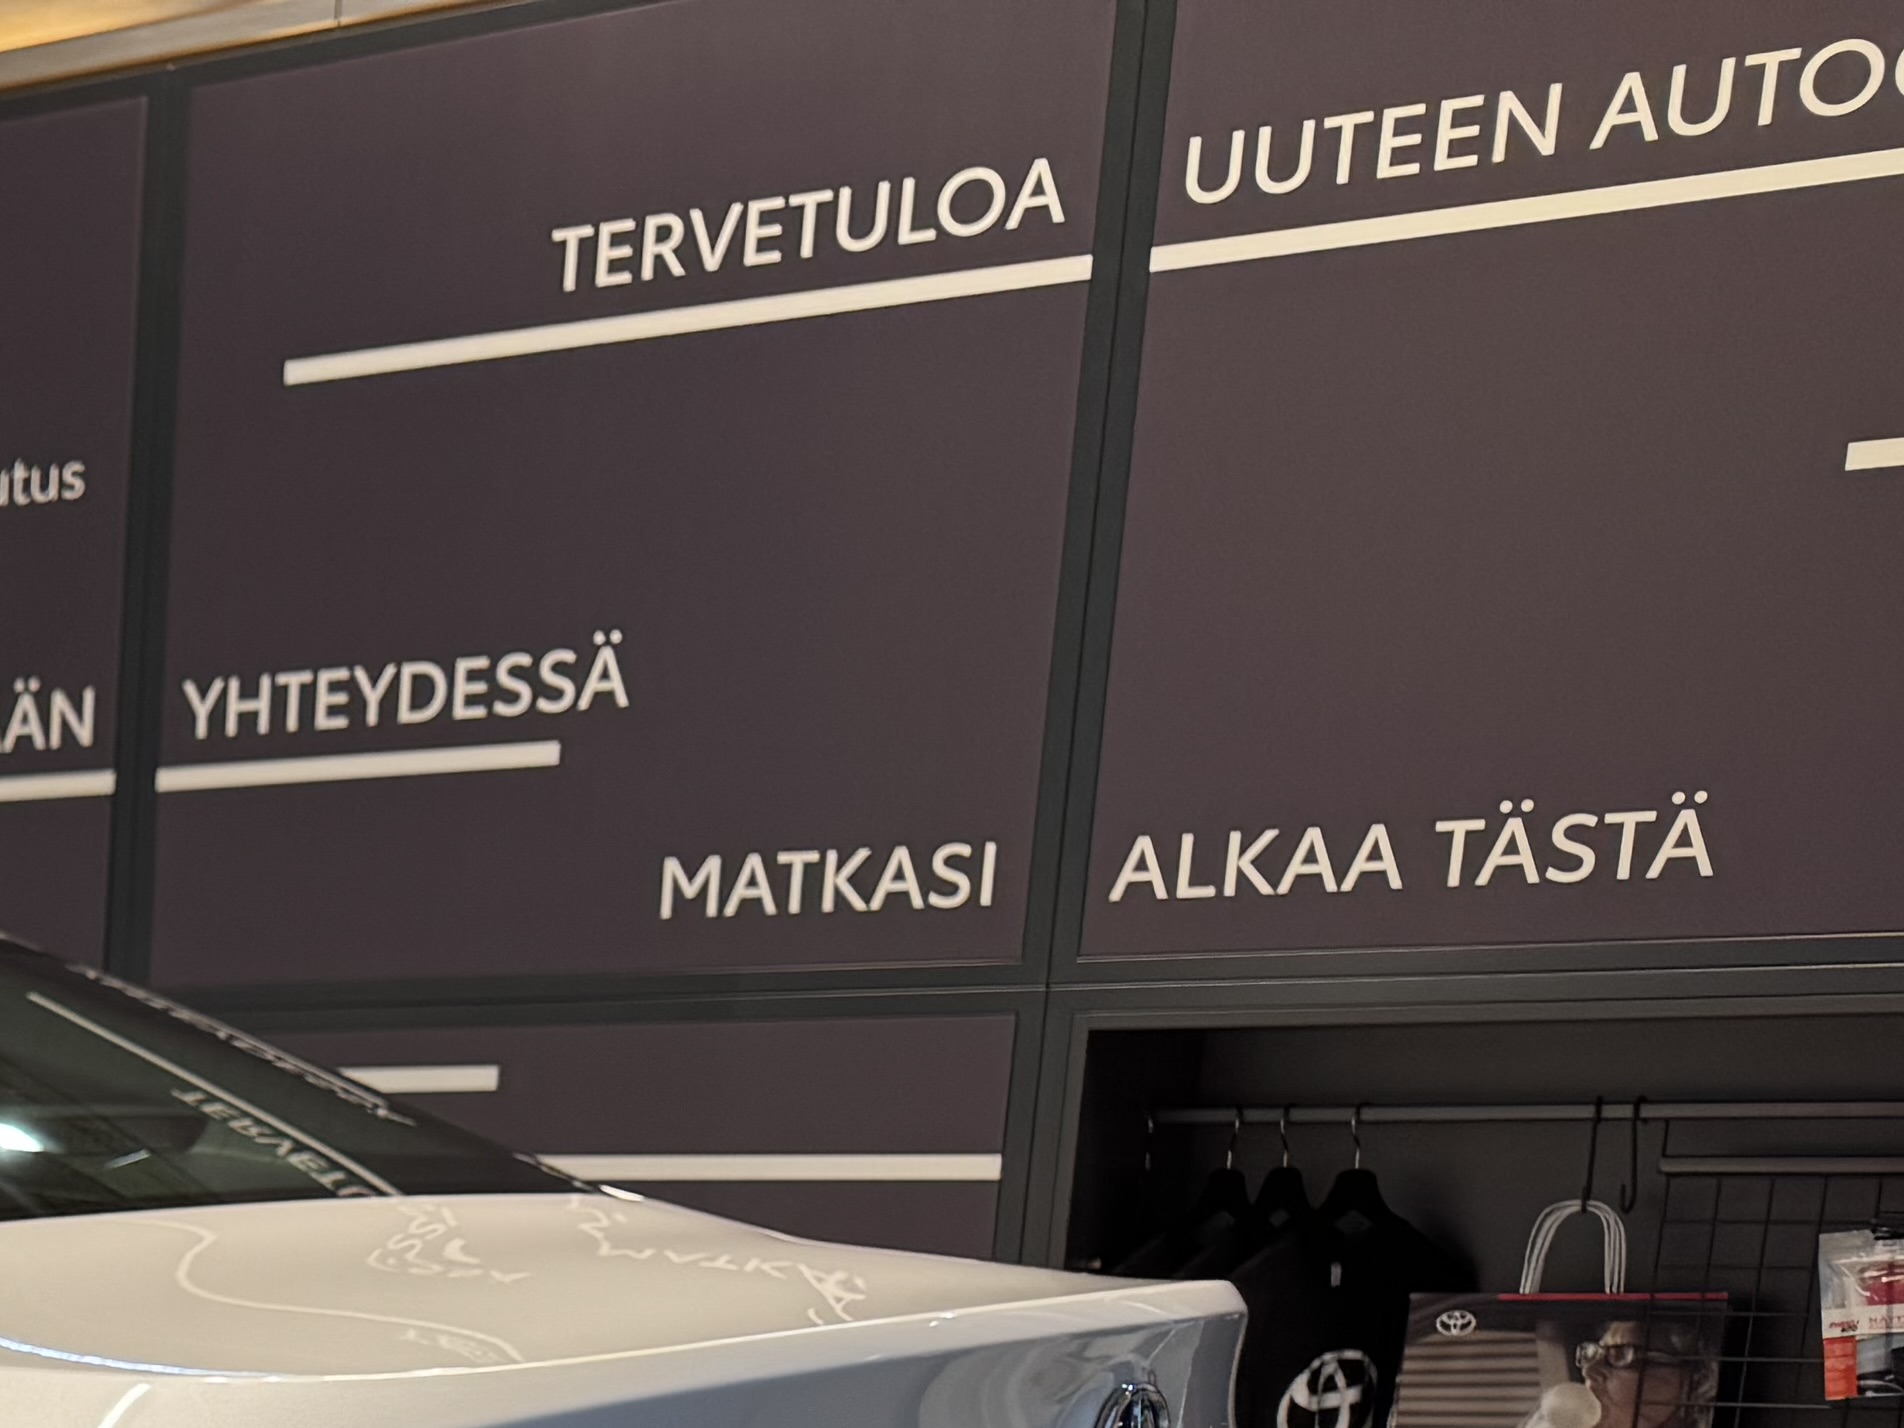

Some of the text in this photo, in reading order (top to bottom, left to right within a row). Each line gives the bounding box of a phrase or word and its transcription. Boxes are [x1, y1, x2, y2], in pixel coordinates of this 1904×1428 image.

[552, 37, 1904, 293] TERVETULOA UUTEEN AUTO
[182, 629, 630, 741] YHTEYDESSÄ
[658, 790, 1715, 922] MATKASI ALKAA TÄSTÄ
